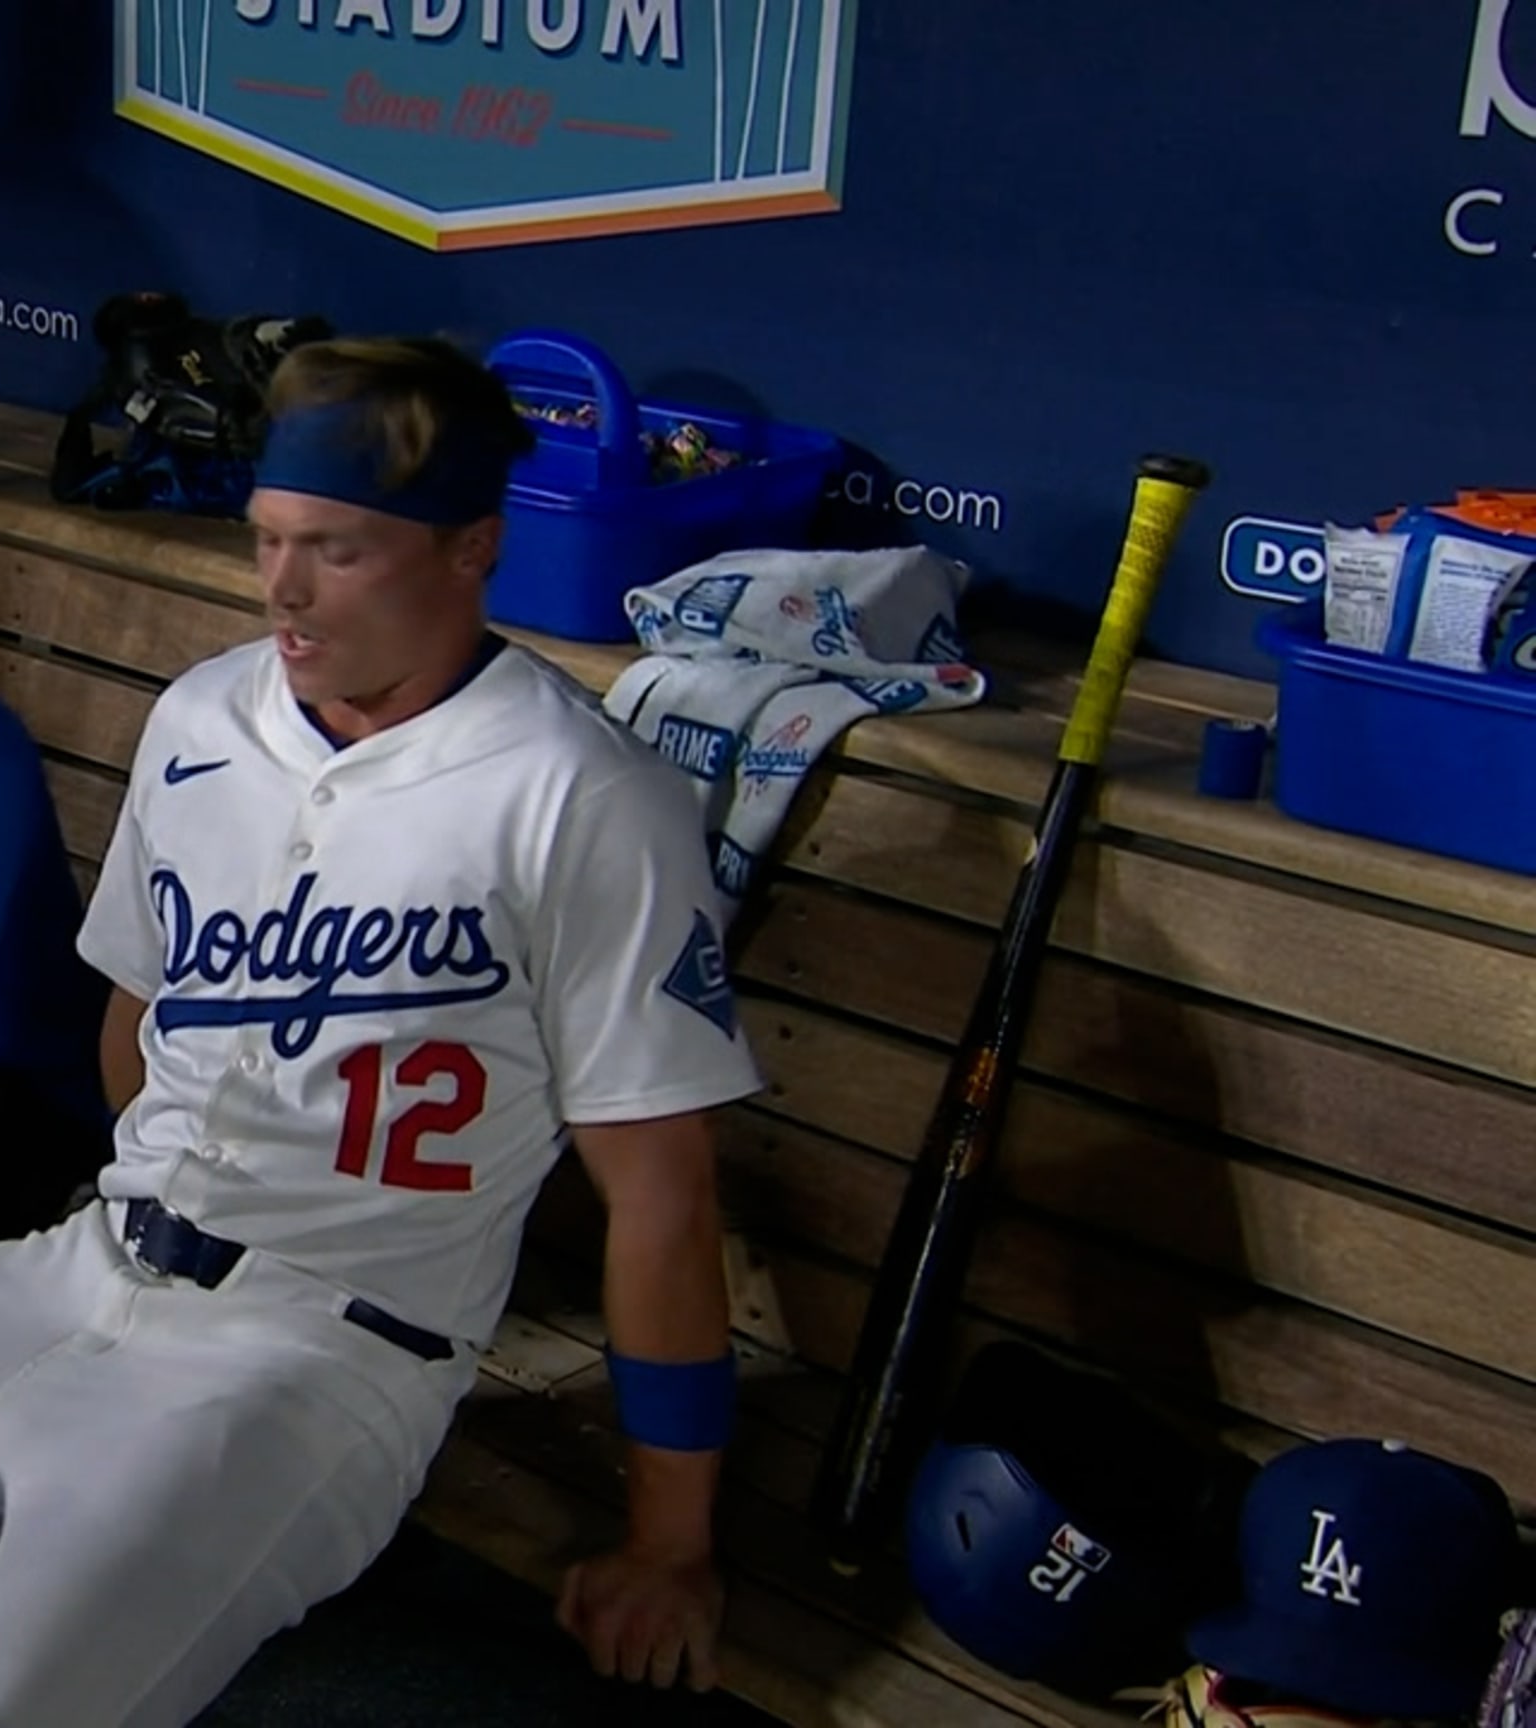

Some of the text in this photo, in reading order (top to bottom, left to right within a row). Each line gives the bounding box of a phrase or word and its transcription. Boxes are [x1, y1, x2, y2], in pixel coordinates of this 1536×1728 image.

[344, 70, 552, 148] Since 1962
[825, 470, 1001, 531] a.com
[150, 870, 510, 1060] Dodgers
[334, 1040, 488, 1192] 12
[1028, 1548, 1087, 1602] 12
[1300, 1509, 1362, 1606] LA
